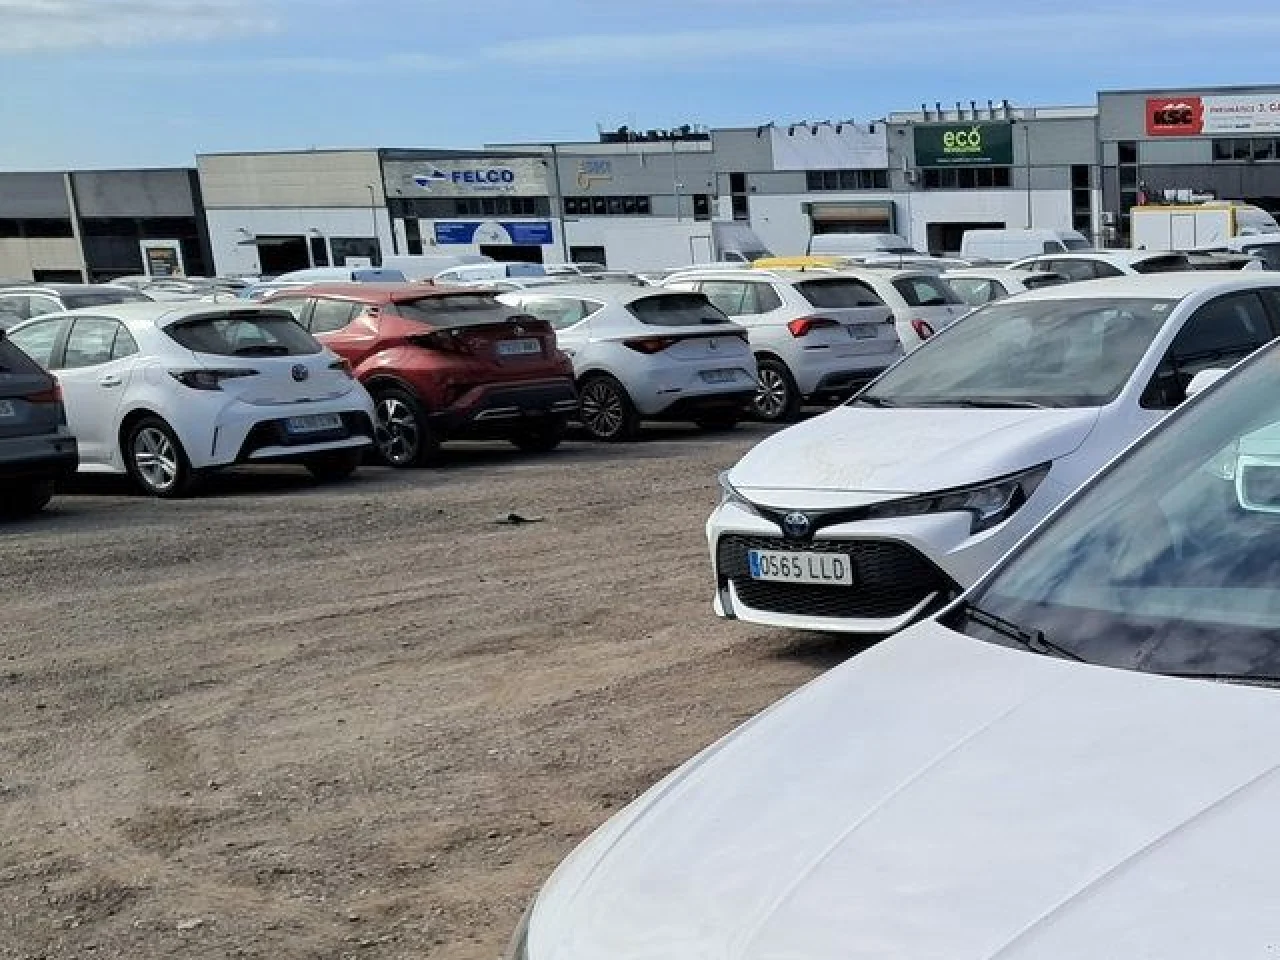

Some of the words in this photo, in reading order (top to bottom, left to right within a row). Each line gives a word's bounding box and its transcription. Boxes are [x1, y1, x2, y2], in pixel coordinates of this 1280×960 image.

[451, 169, 515, 183] FELCO
[760, 555, 802, 578] 0565
[808, 557, 844, 580] LLD
